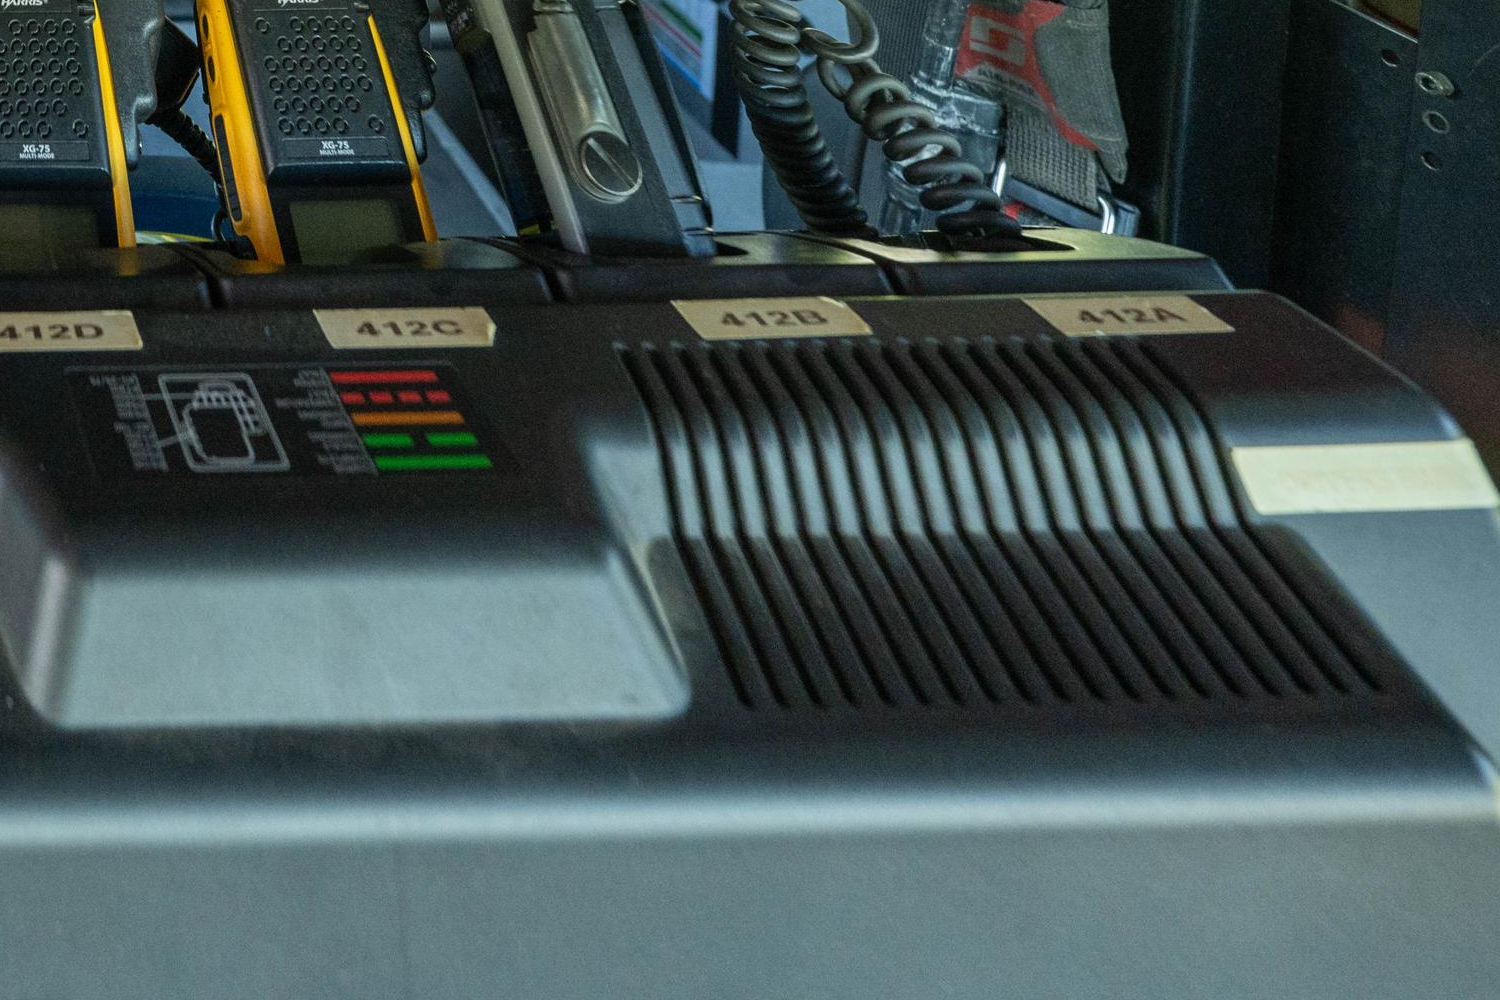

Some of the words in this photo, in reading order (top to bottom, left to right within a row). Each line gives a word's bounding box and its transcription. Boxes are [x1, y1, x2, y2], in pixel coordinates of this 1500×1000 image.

[22, 143, 51, 153] XG-75
[321, 140, 350, 150] XG-75
[721, 310, 828, 327] 412B
[1079, 306, 1187, 323] 412A
[357, 320, 465, 336] 412C
